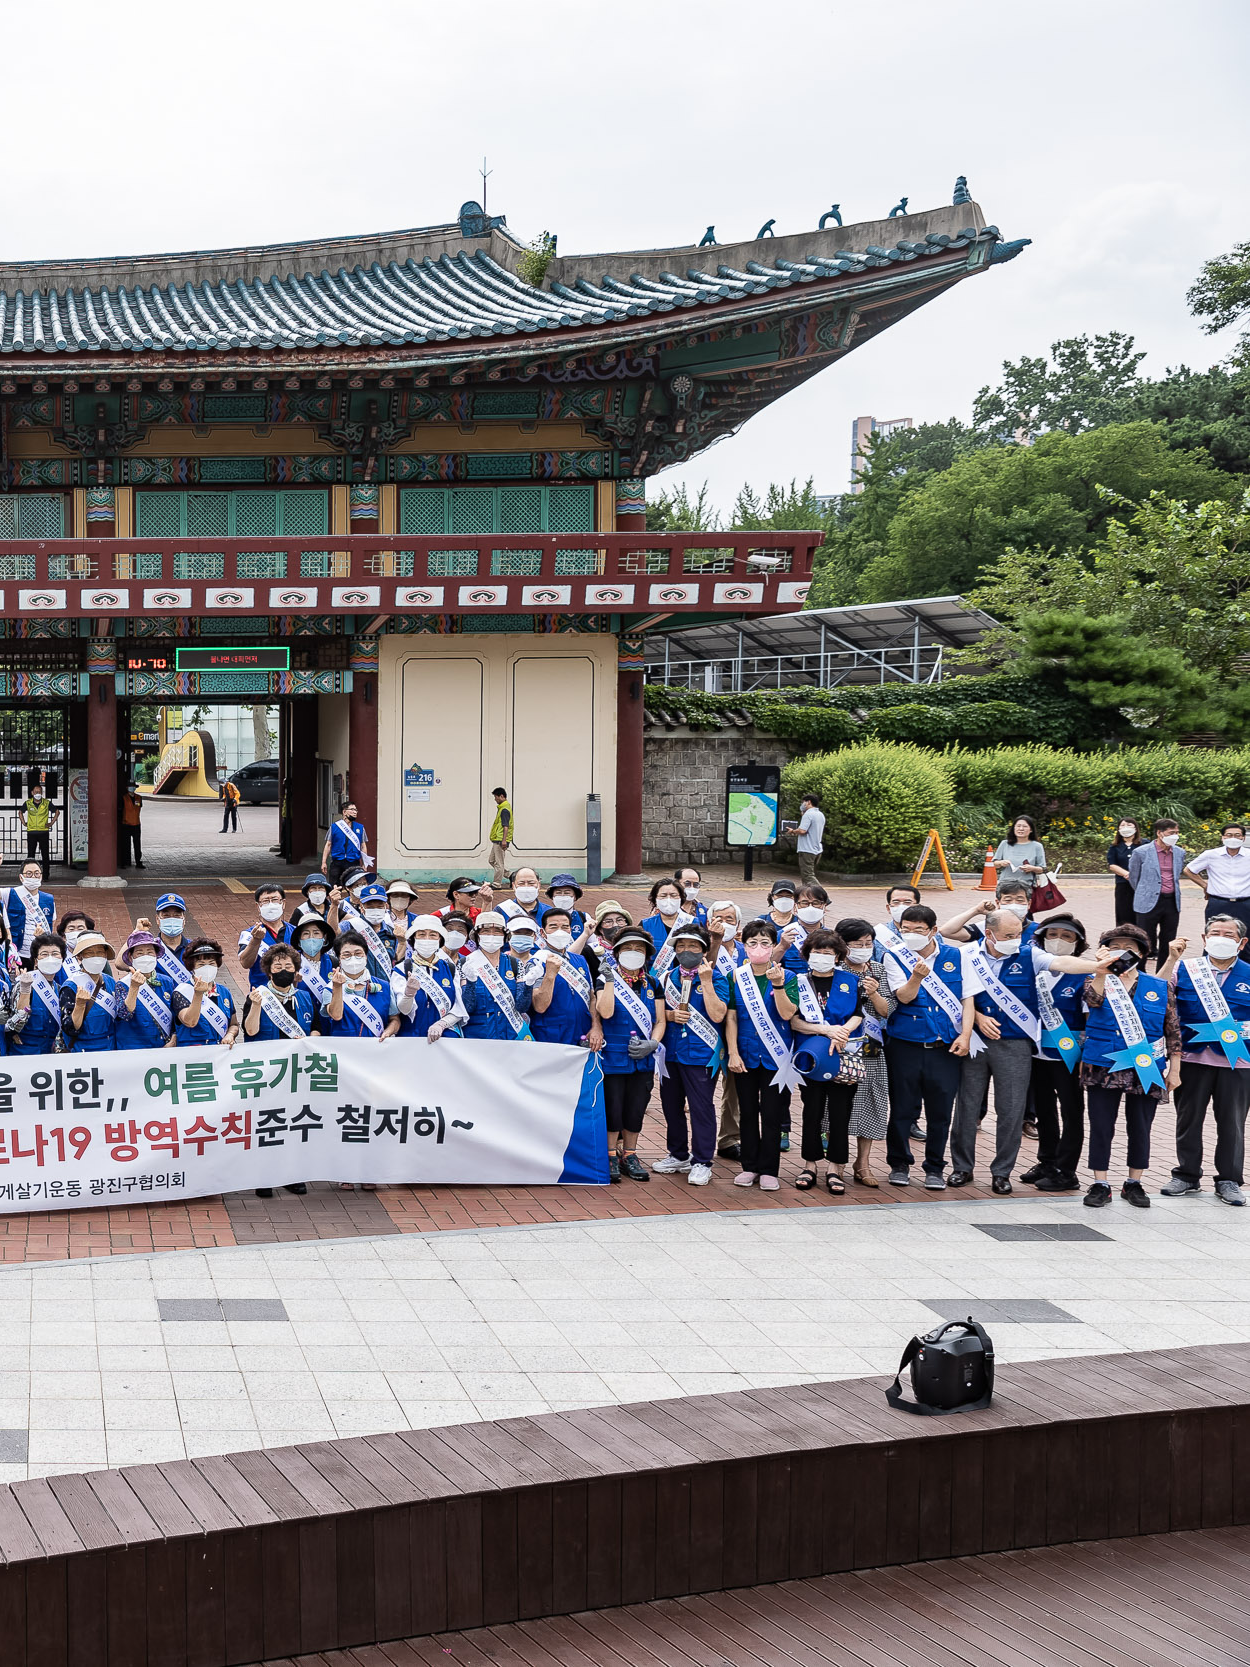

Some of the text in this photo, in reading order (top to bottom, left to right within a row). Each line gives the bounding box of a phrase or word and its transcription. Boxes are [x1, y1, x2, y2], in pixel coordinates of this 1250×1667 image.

[231, 655, 258, 664] 대피먼저
[418, 773, 433, 782] 216
[972, 957, 1029, 1022] 바르게살기운동
[144, 1060, 219, 1106] 여름
[231, 1053, 340, 1099] 휴가철
[335, 1103, 476, 1148] 철저히~
[89, 1171, 187, 1196] 광진구협의회
